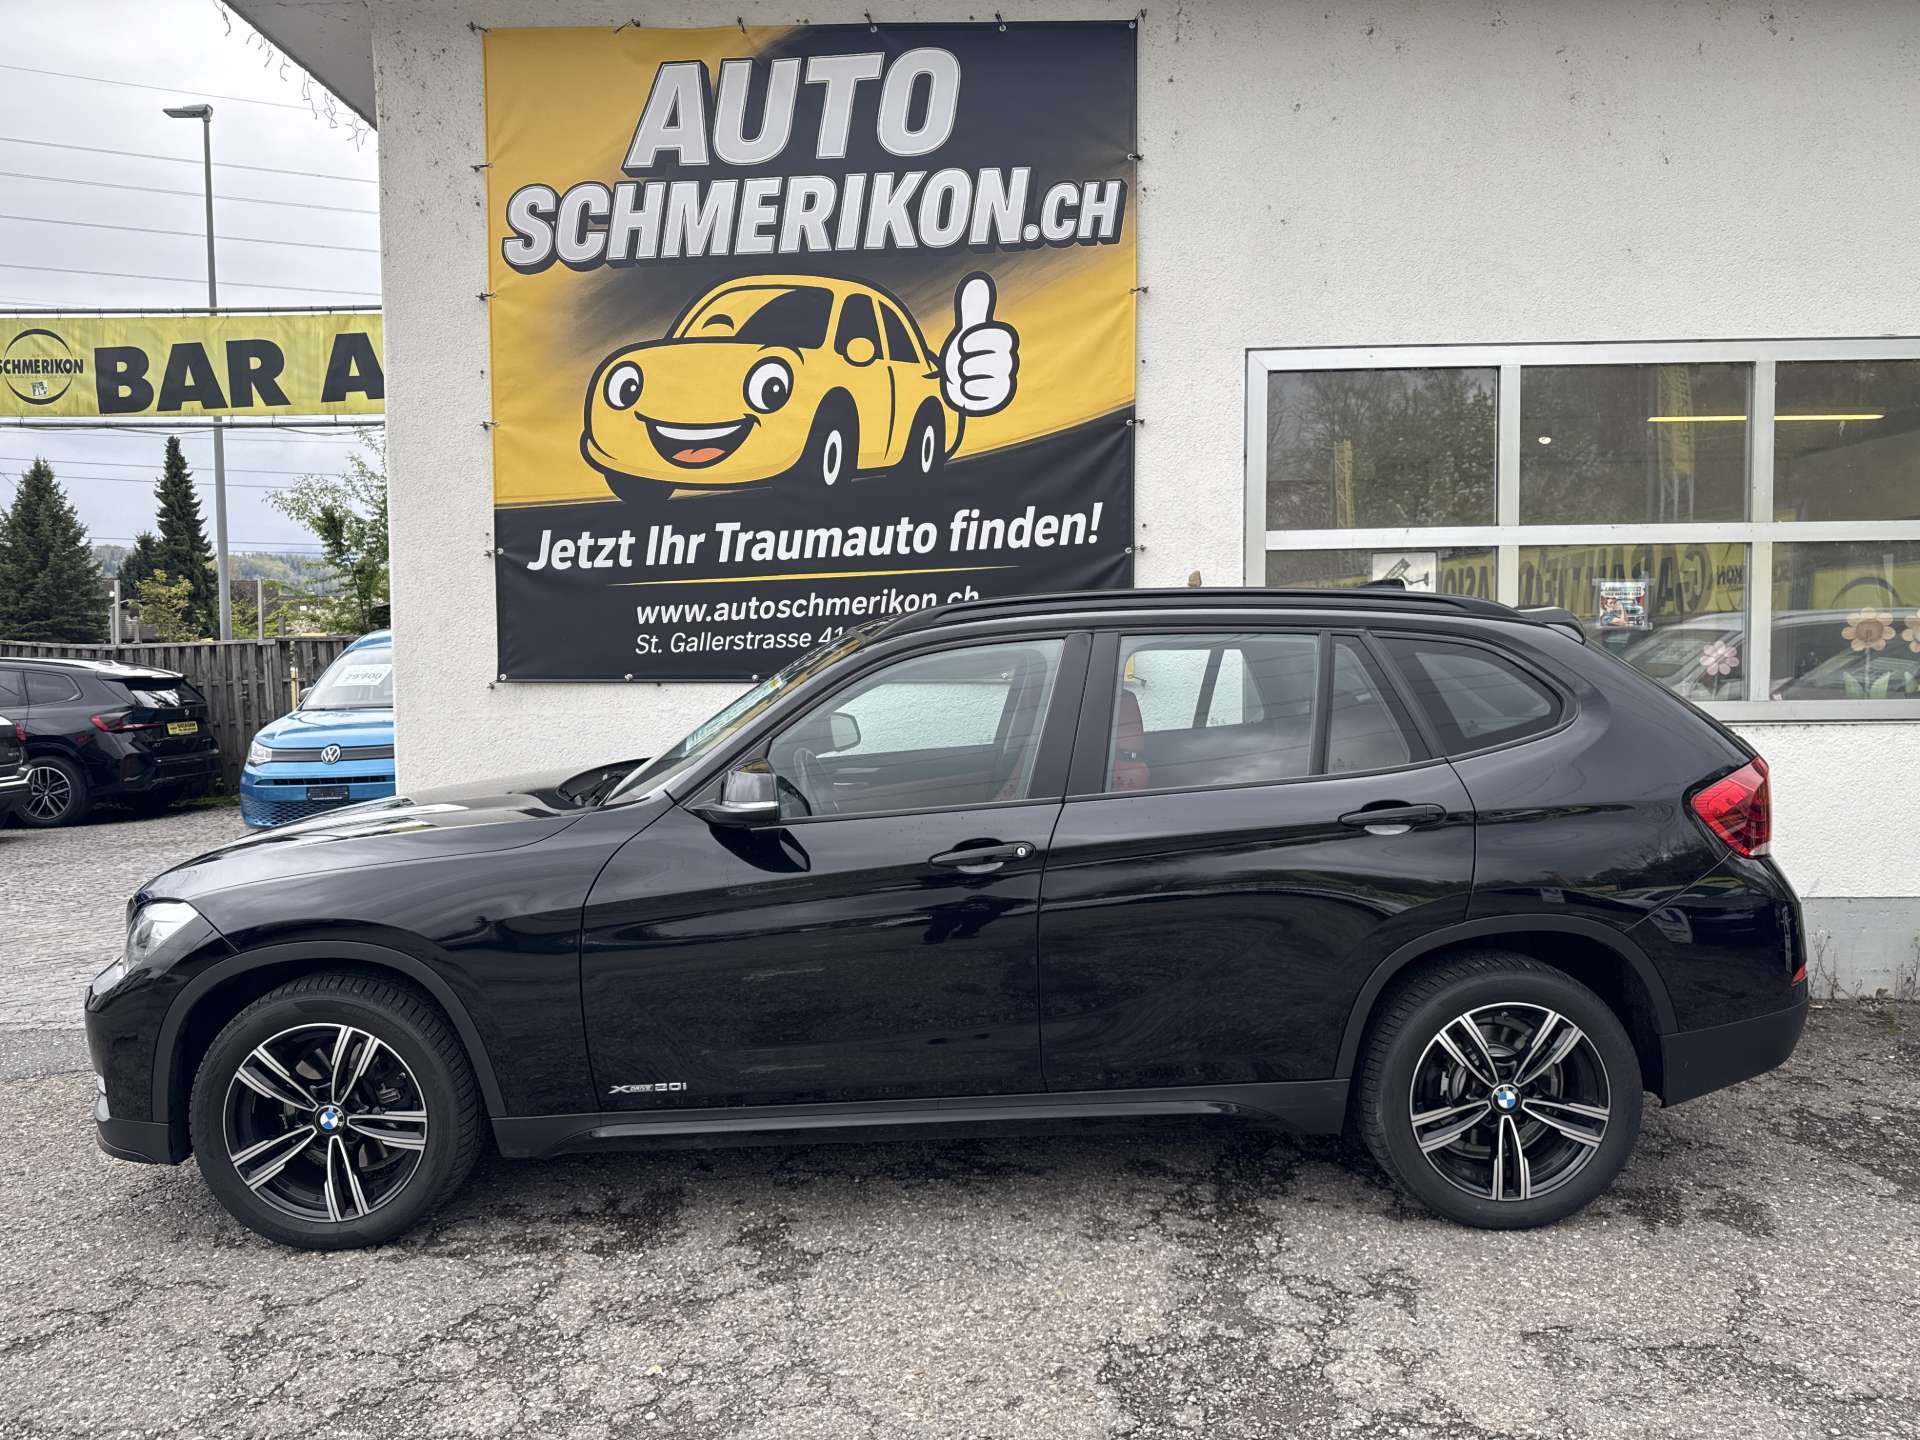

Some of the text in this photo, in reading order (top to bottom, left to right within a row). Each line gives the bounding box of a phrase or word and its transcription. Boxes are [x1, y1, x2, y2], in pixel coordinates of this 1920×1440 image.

[621, 46, 961, 170] AUTO
[502, 165, 1127, 266] SCHMERIKON.CH
[94, 339, 292, 415] BAR
[527, 502, 1104, 572] Jetzt Ihr Traumauto finden!
[635, 633, 662, 654] St.
[670, 622, 812, 651] Gallerstrasse
